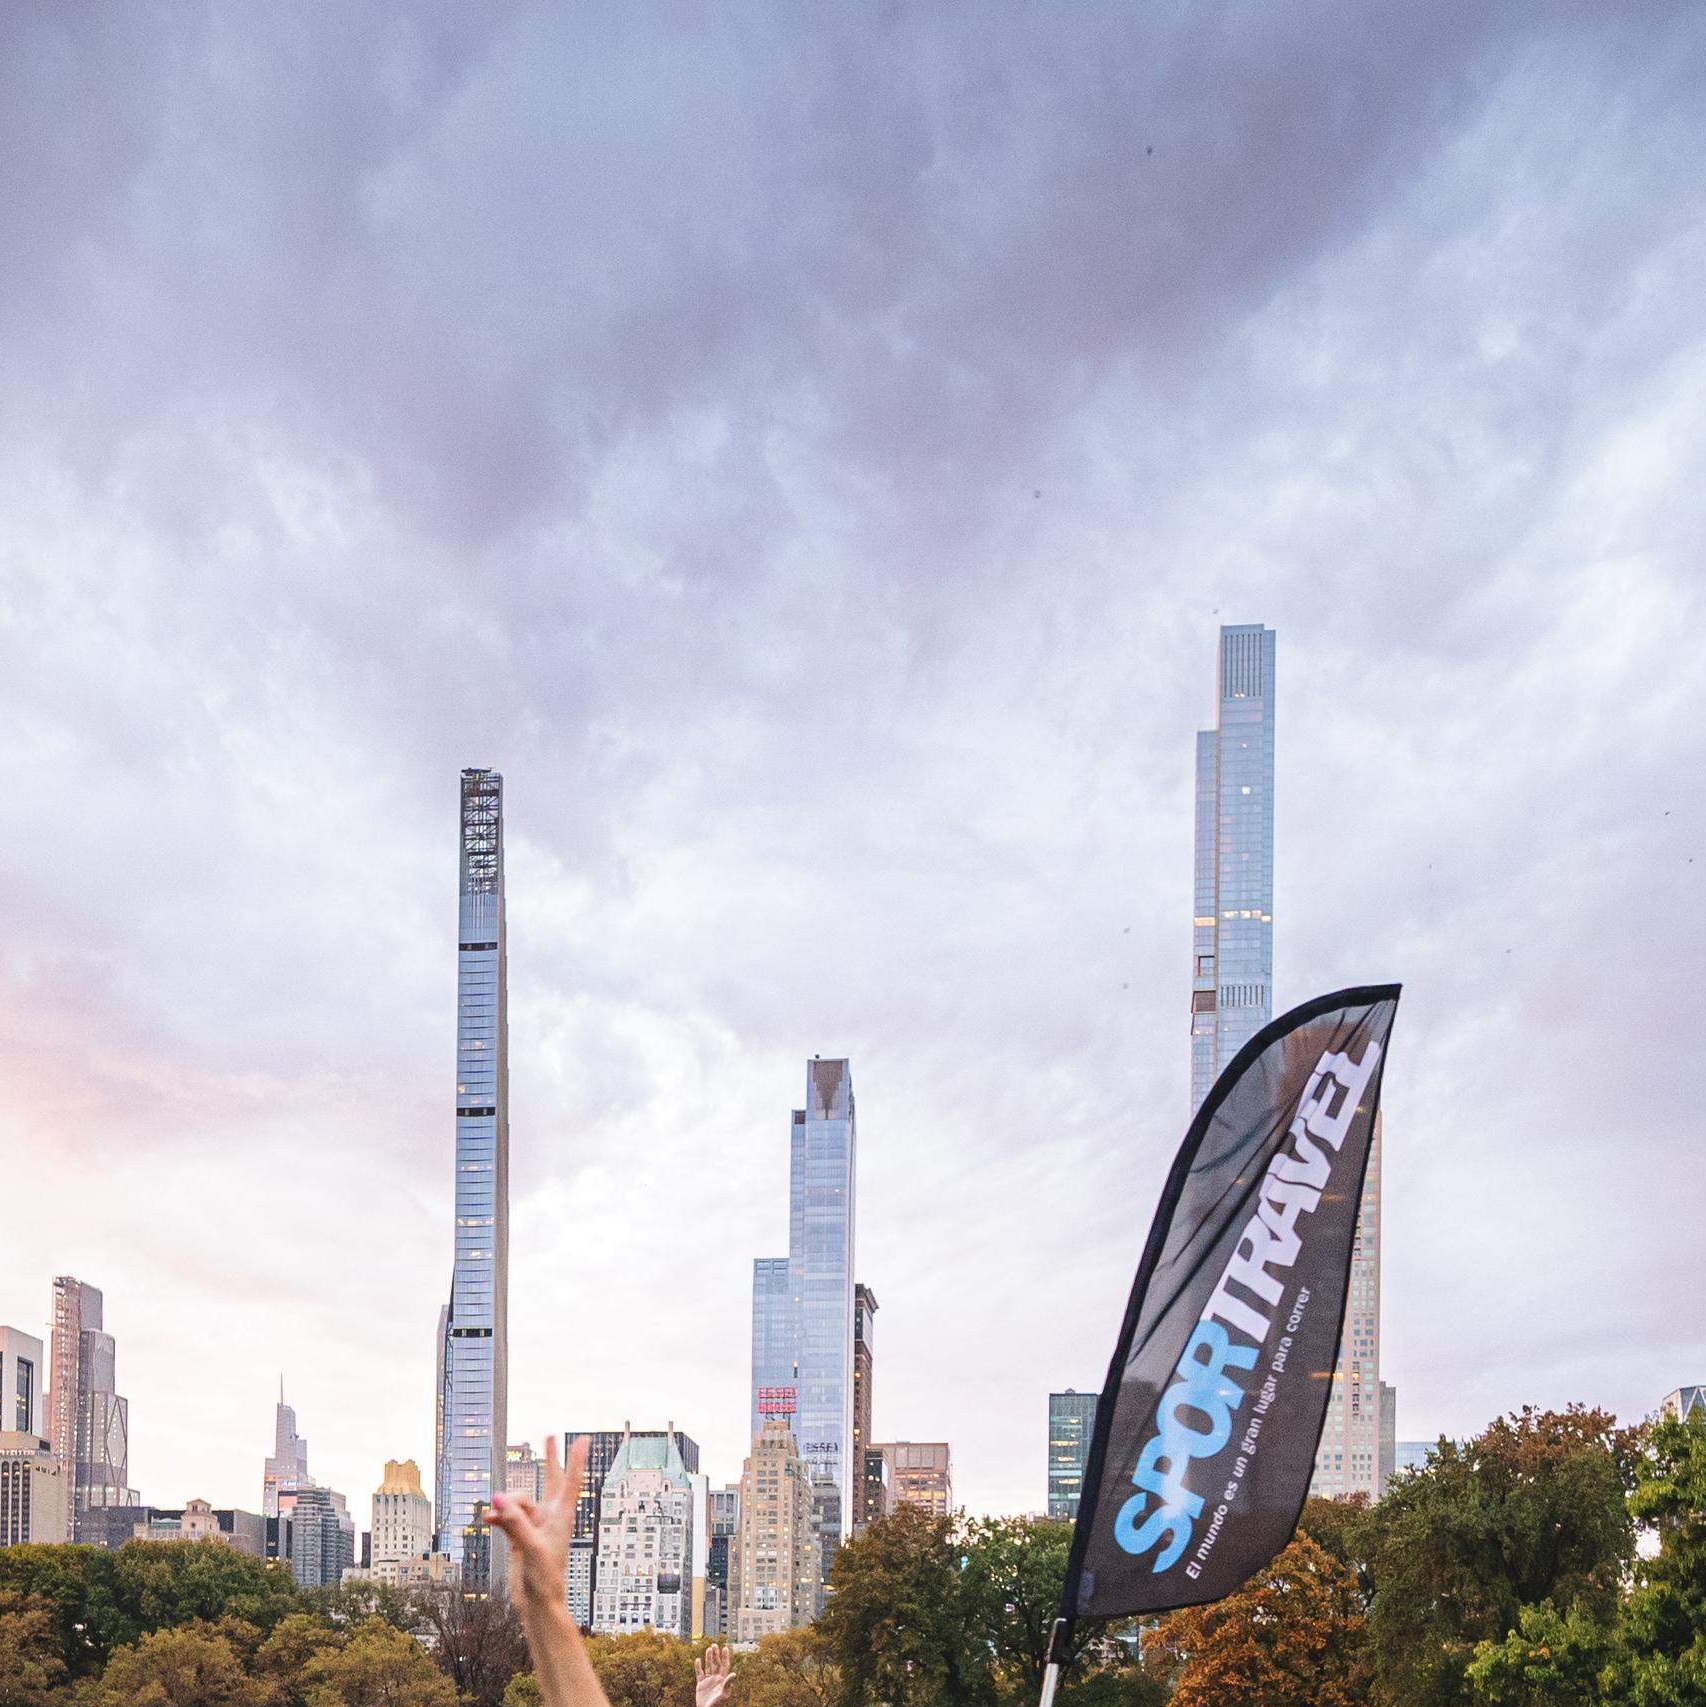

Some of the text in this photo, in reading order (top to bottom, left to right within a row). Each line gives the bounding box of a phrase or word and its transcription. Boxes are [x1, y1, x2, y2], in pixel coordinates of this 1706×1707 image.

[1185, 1286, 1311, 1580] El mundo es un gran lugar para correr
